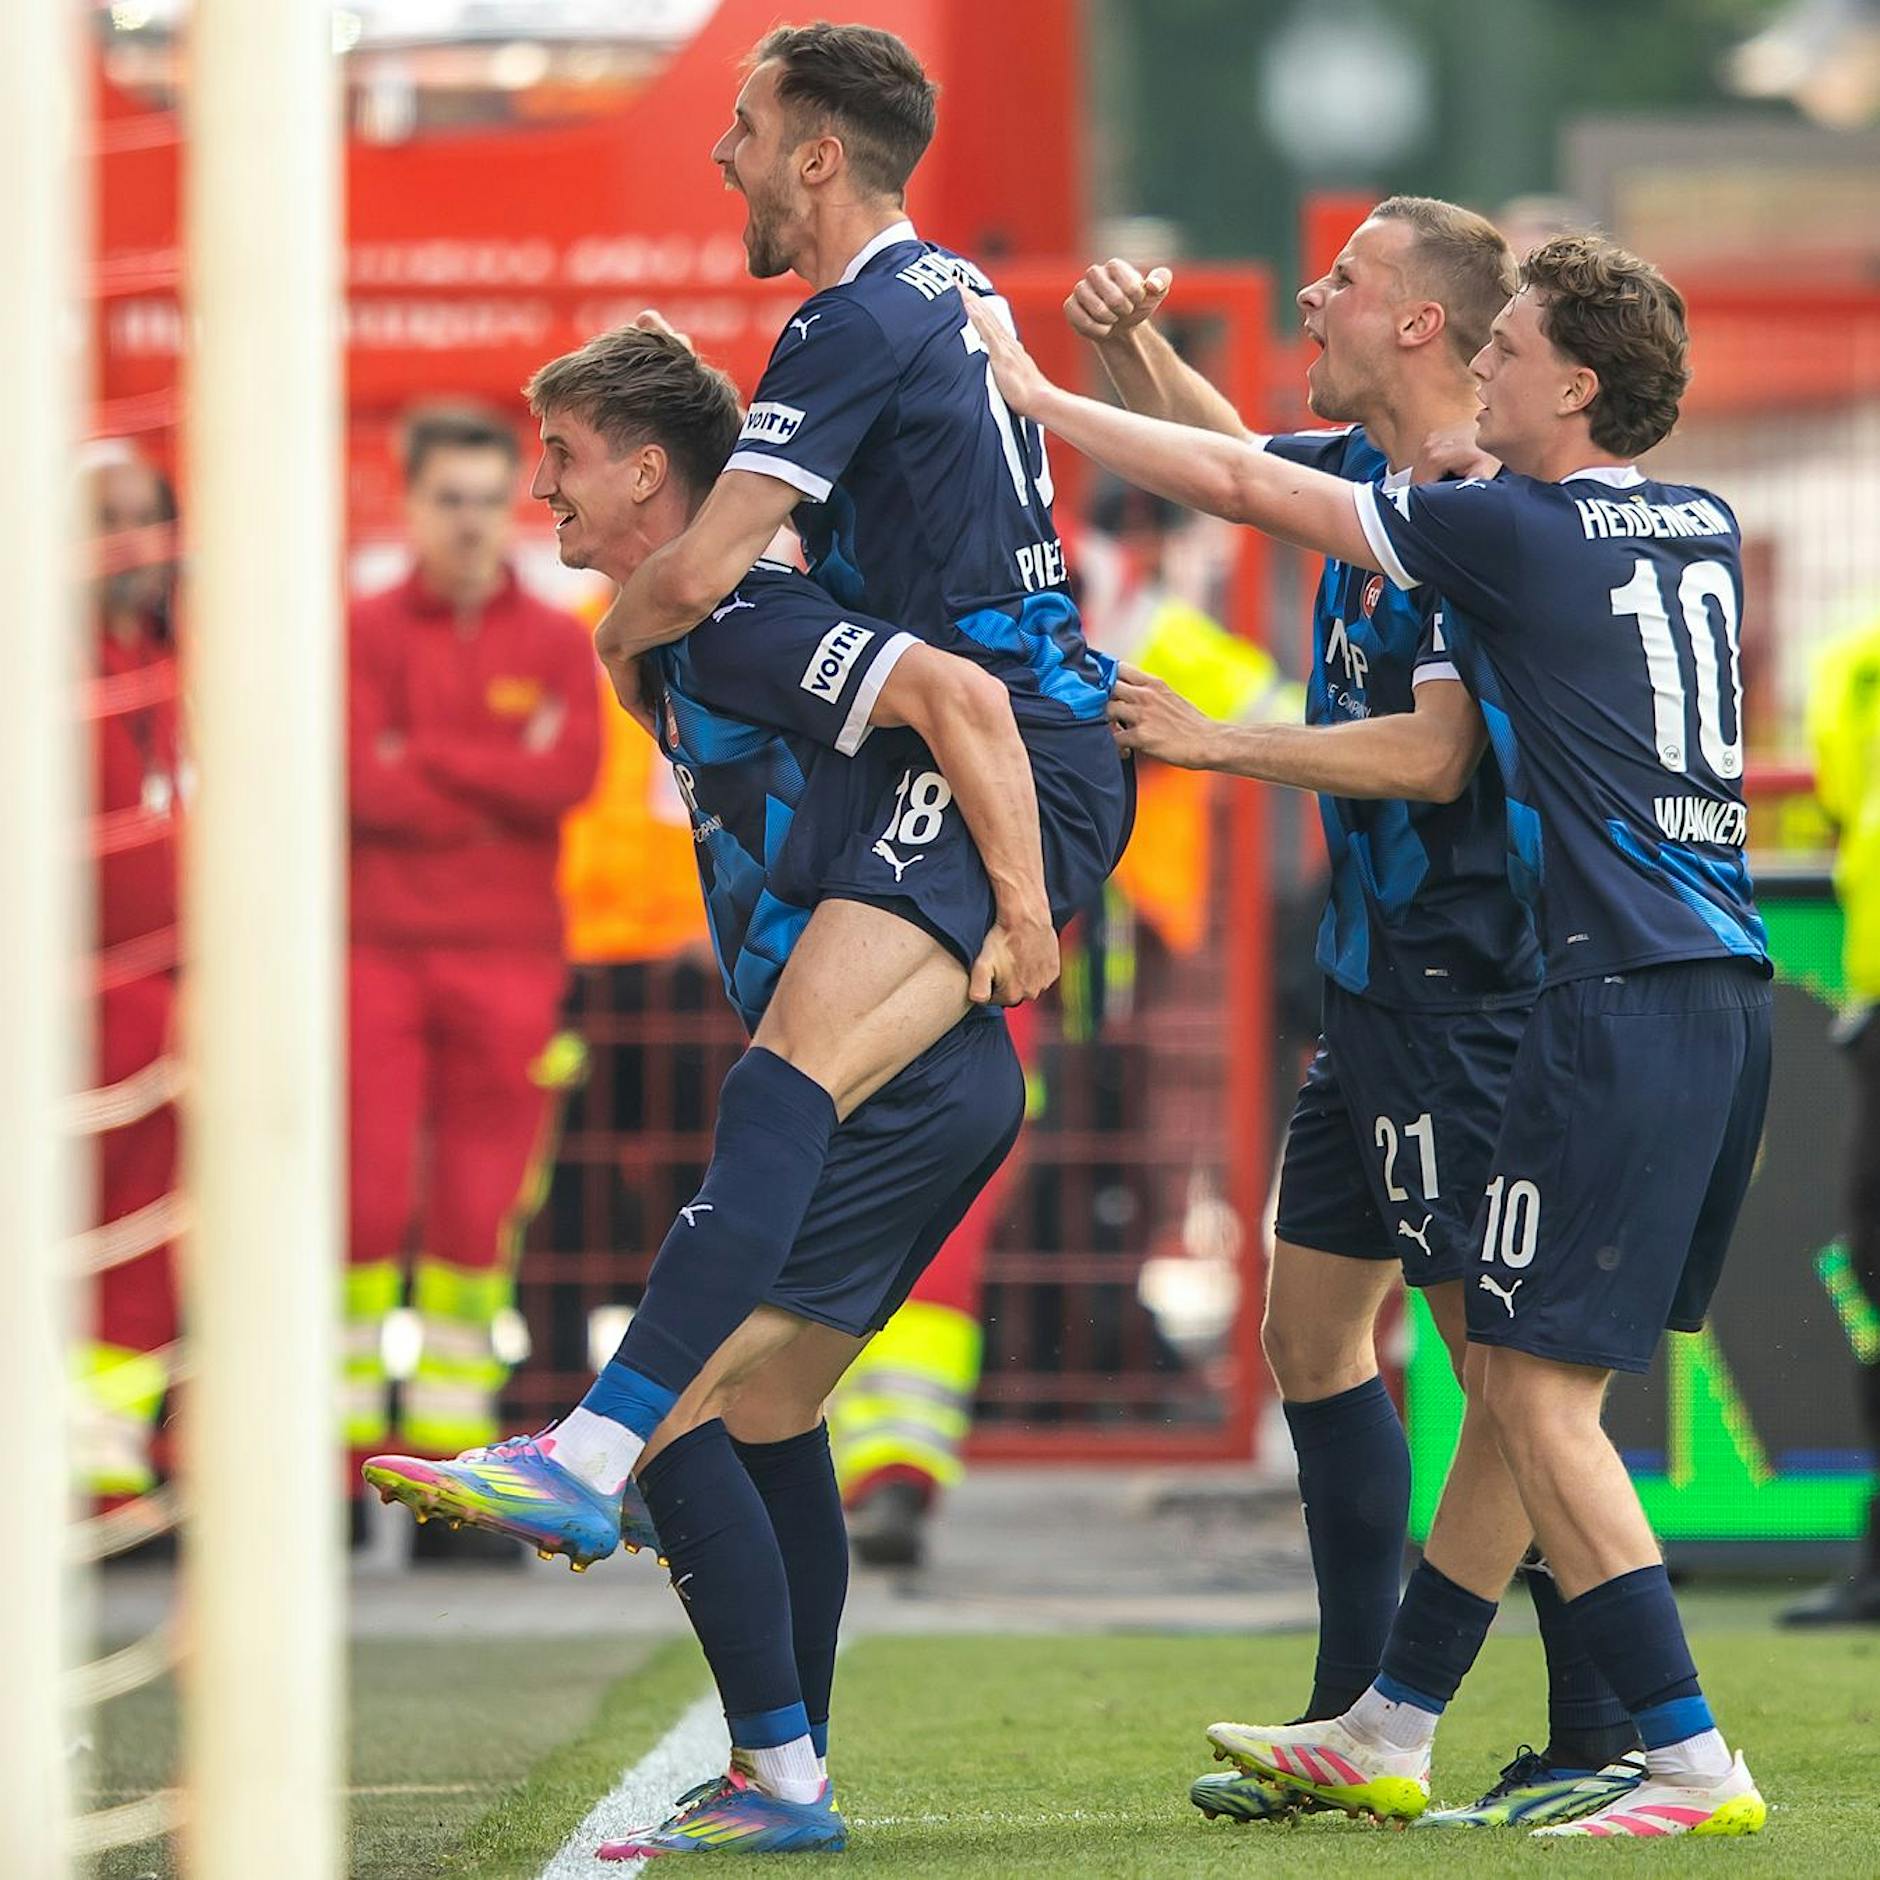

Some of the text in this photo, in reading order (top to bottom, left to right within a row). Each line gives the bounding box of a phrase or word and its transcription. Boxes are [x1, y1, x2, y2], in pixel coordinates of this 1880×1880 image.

[747, 411, 798, 436] VOITH
[811, 626, 864, 694] VOITH
[1610, 558, 1743, 780] 10
[881, 769, 952, 845] 18
[1653, 796, 1748, 847] WANNER
[1375, 1113, 1440, 1202] 21
[1480, 1176, 1541, 1268] 10
